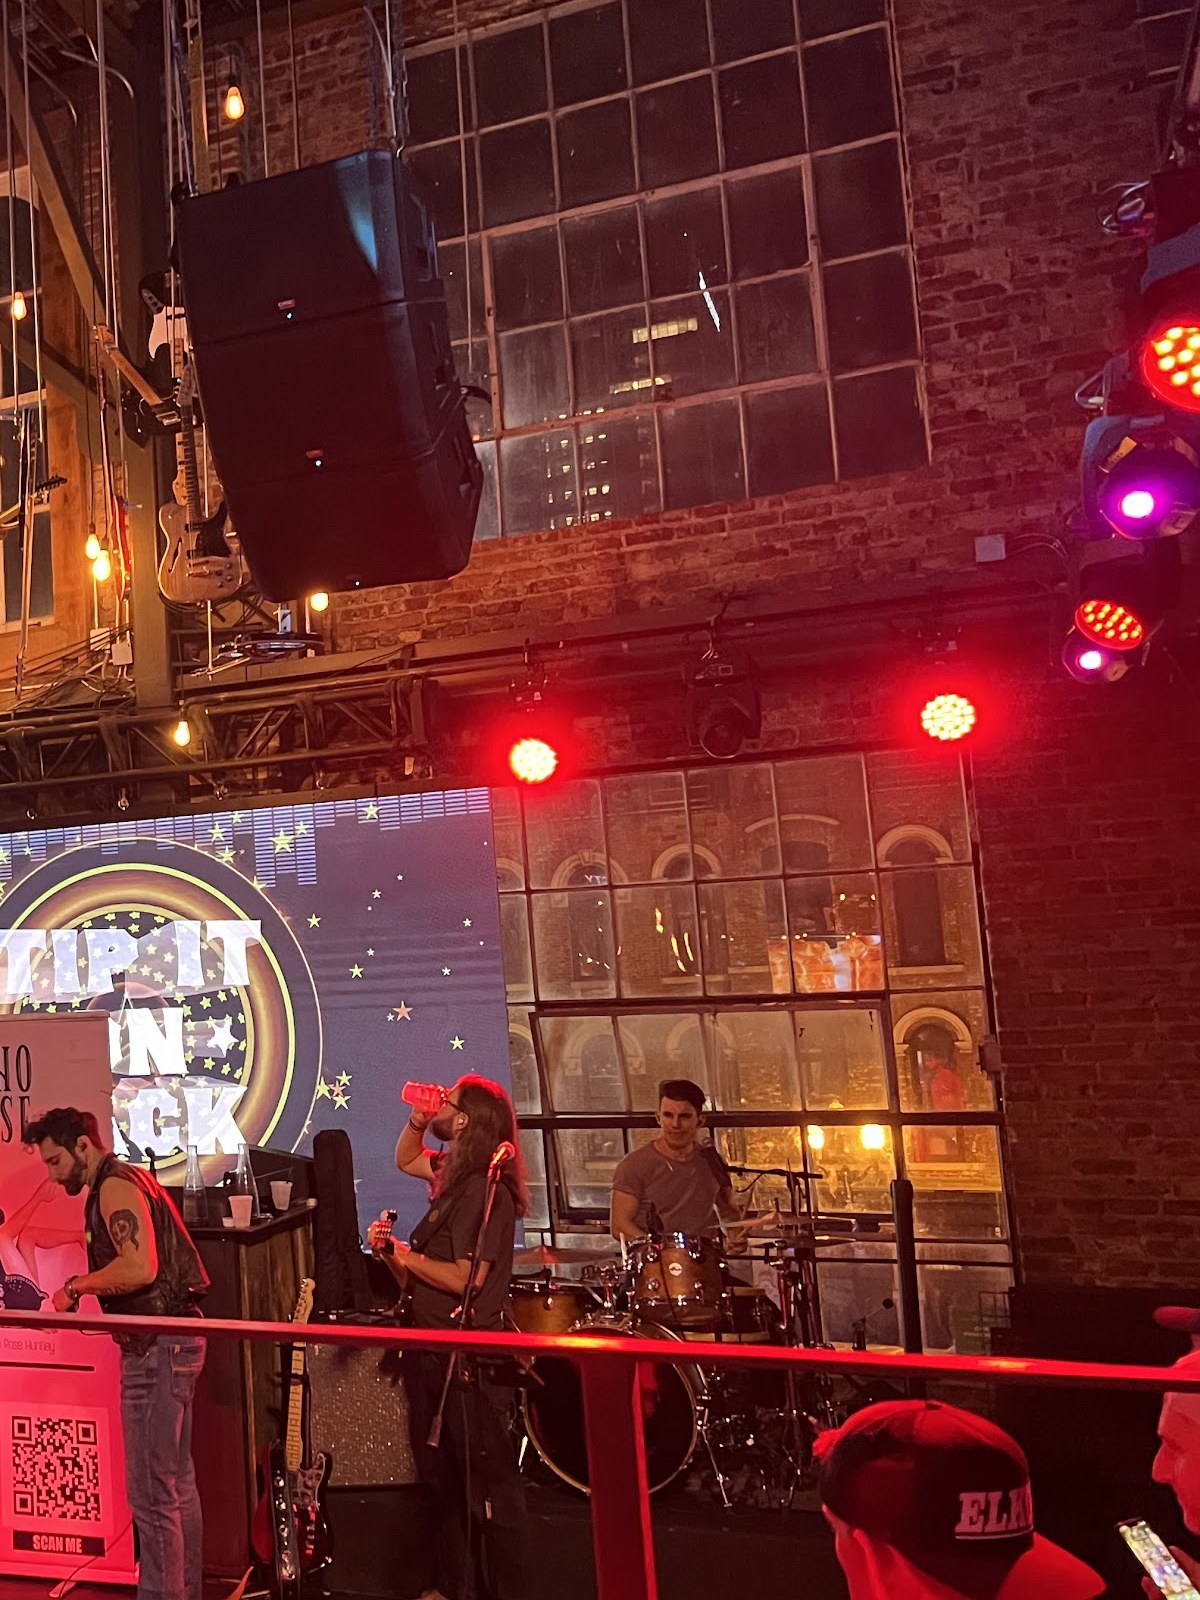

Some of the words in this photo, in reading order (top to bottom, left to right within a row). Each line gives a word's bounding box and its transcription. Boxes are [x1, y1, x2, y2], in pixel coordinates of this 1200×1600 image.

[172, 920, 262, 987] IT
[112, 1085, 248, 1157] CK
[32, 1534, 64, 1552] SCAN
[65, 1537, 83, 1554] ME
